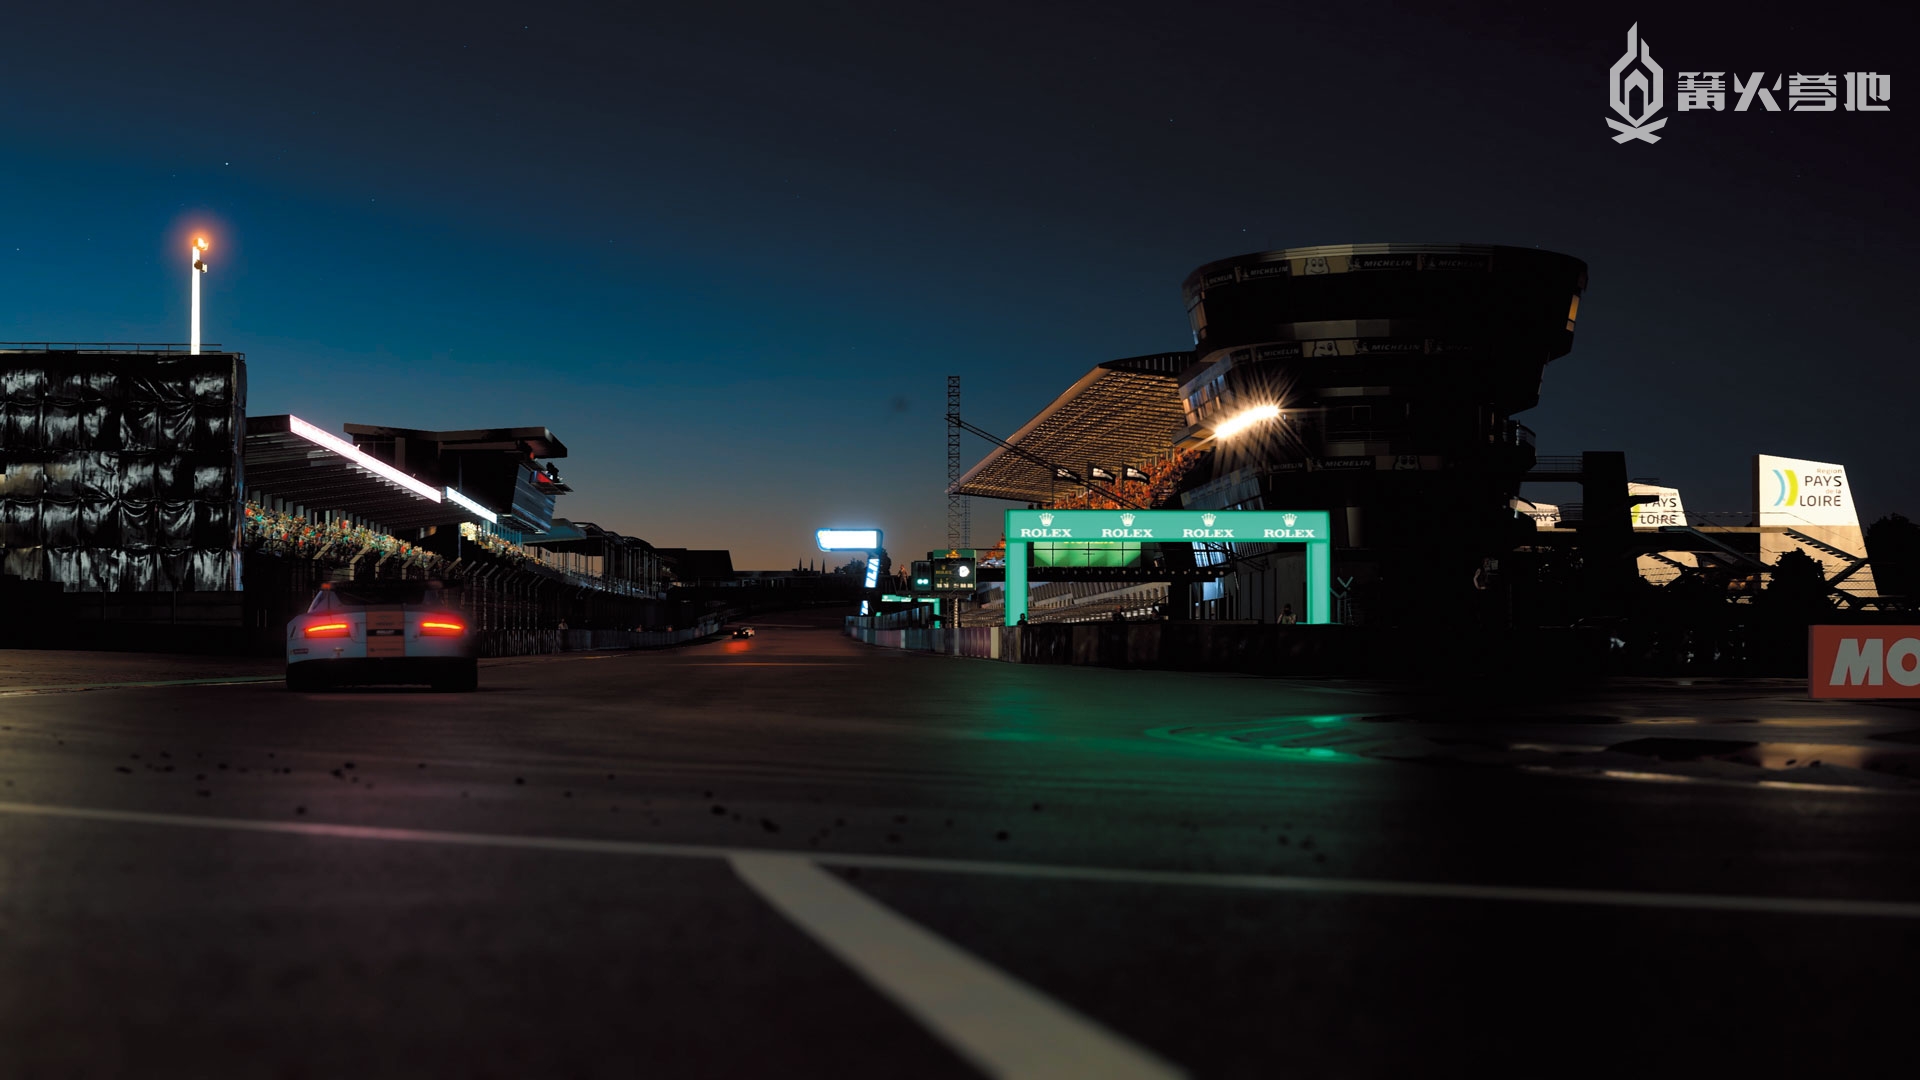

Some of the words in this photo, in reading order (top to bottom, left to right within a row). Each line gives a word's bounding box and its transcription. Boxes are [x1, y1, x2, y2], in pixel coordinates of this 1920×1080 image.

[1364, 259, 1413, 269] MICHELIN
[1250, 265, 1288, 276] MICHELIN
[1264, 347, 1299, 357] MICHELIN
[1325, 458, 1372, 468] MICHELIN
[1805, 475, 1841, 487] PAYS
[1800, 495, 1841, 507] LOIRE
[1641, 514, 1677, 525] LOIRE
[1020, 528, 1072, 538] ROLEX
[1101, 528, 1153, 538] ROLEX
[1182, 528, 1235, 538] ROLEX
[1263, 528, 1316, 538] ROLEX
[1829, 637, 1920, 687] MO
